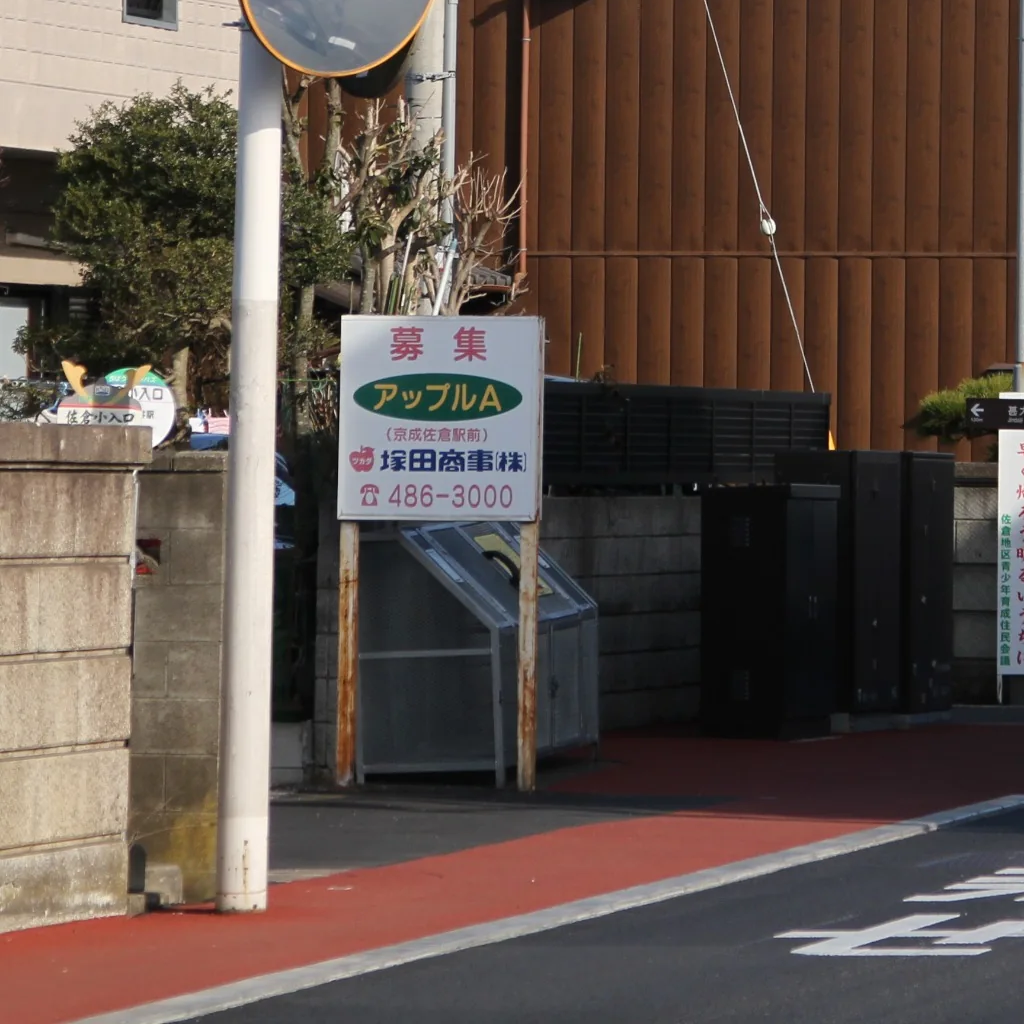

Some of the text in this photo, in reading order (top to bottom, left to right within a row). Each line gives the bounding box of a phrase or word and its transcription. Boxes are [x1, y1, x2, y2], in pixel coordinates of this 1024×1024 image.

[390, 326, 487, 362] 募集
[373, 383, 502, 412] アップルA
[66, 409, 135, 425] 佐倉小入口
[352, 456, 372, 465] ツカダ
[388, 484, 513, 508] 486-3000
